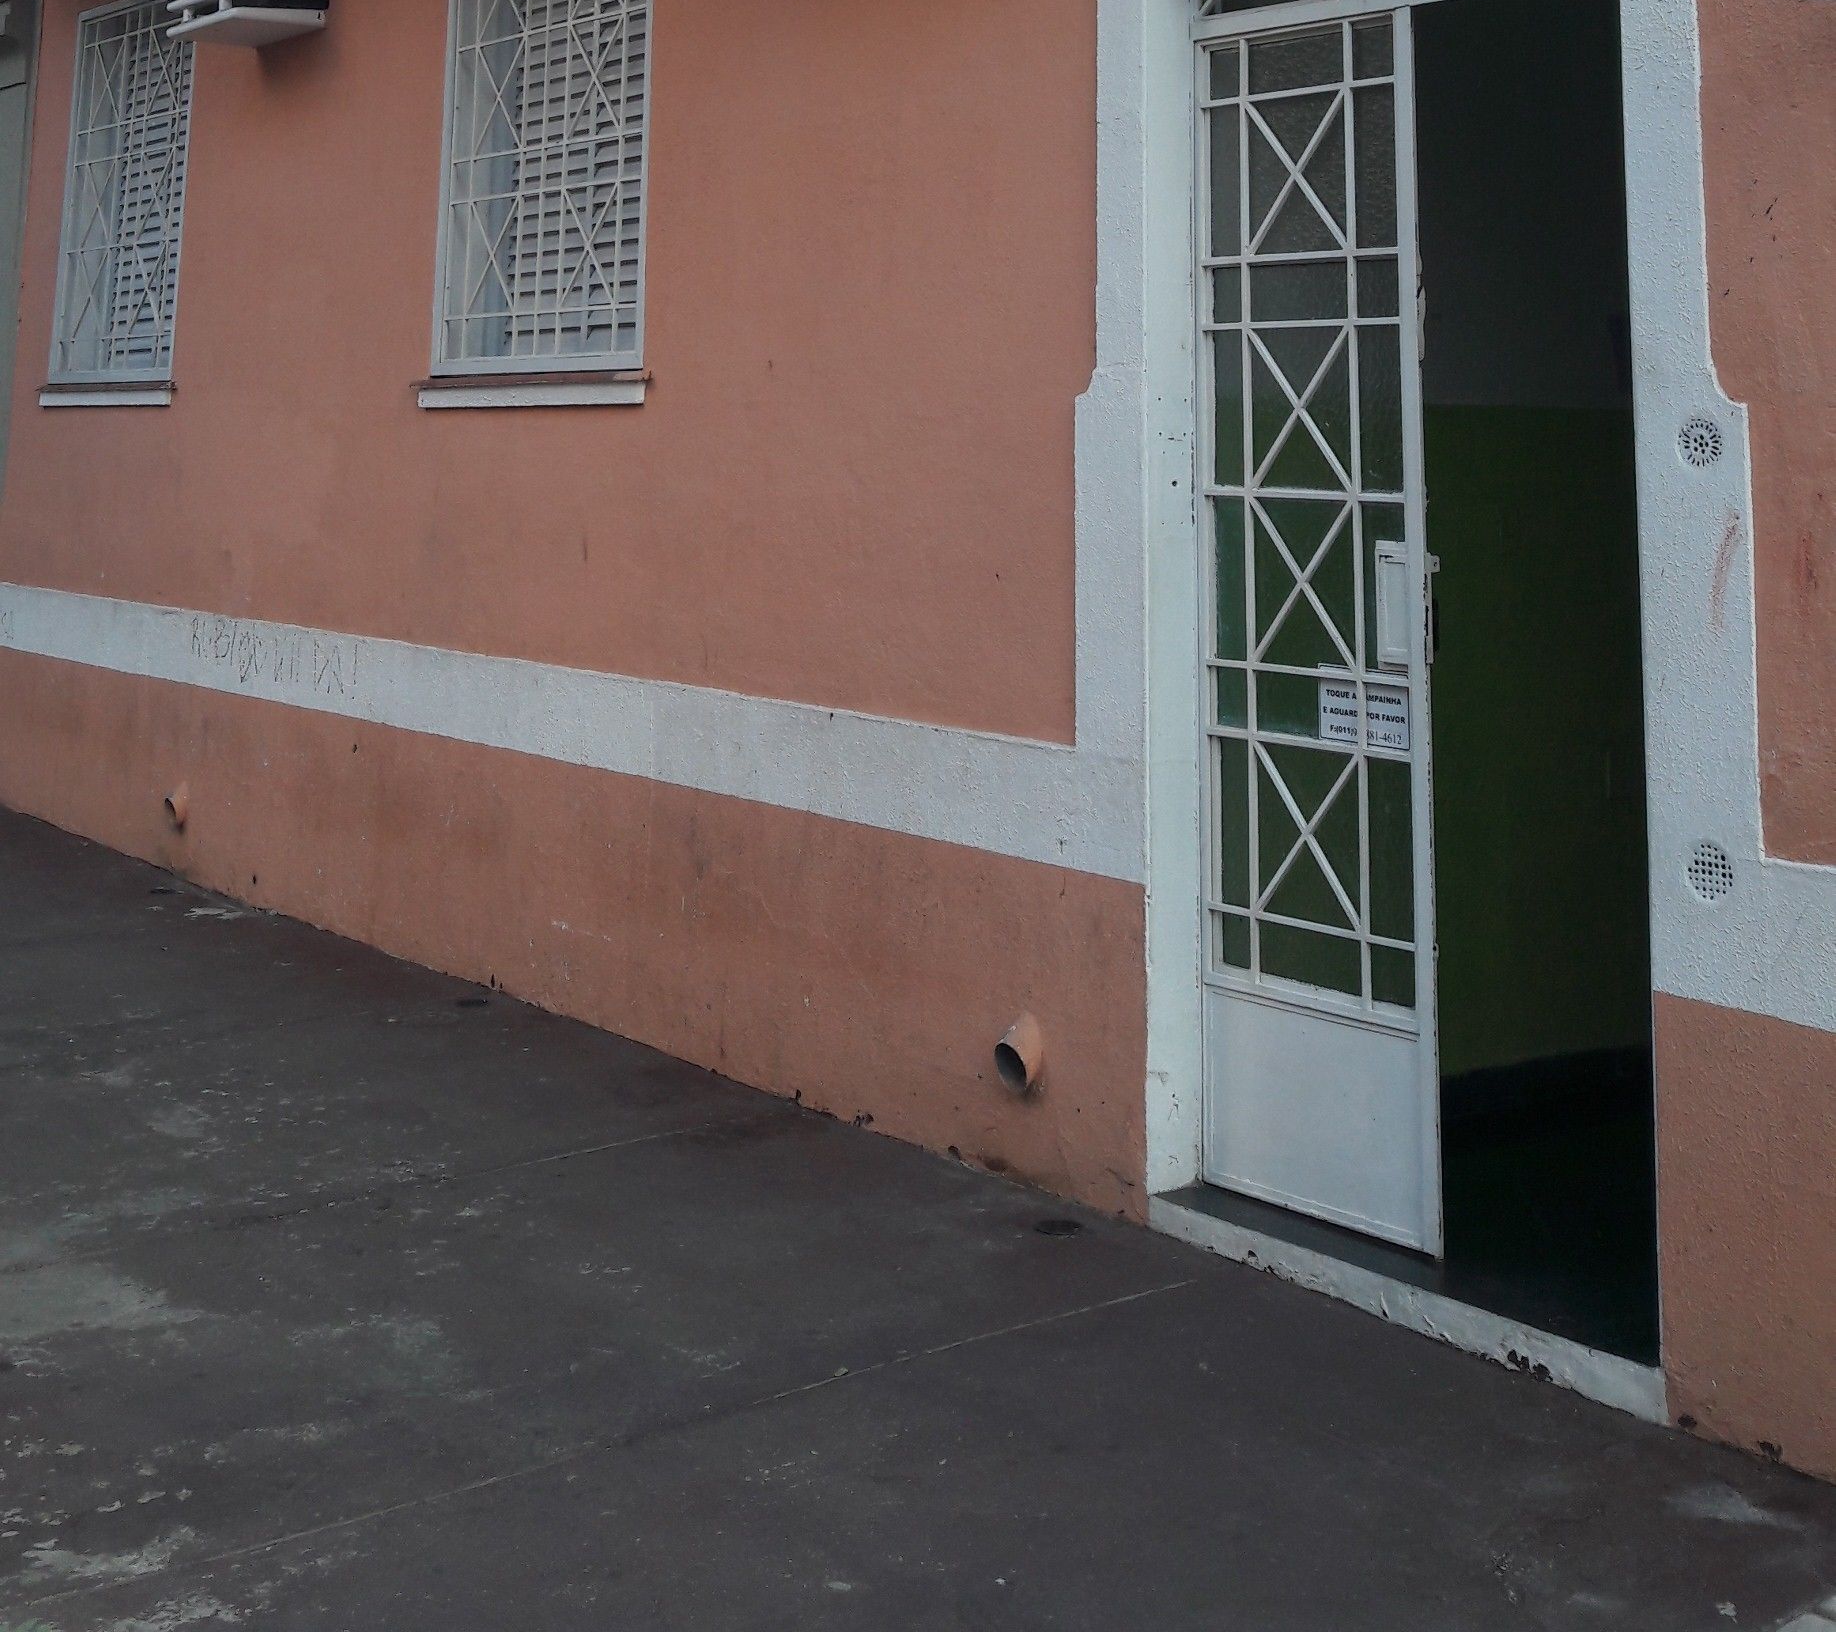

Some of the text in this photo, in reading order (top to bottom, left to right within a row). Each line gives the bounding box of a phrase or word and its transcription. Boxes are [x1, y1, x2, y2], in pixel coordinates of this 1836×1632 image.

[1326, 688, 1402, 706] TOQUE A AMPAINHA
[1323, 706, 1327, 714] E
[1329, 707, 1360, 718] AGUARD
[1382, 714, 1406, 725] FAVOR
